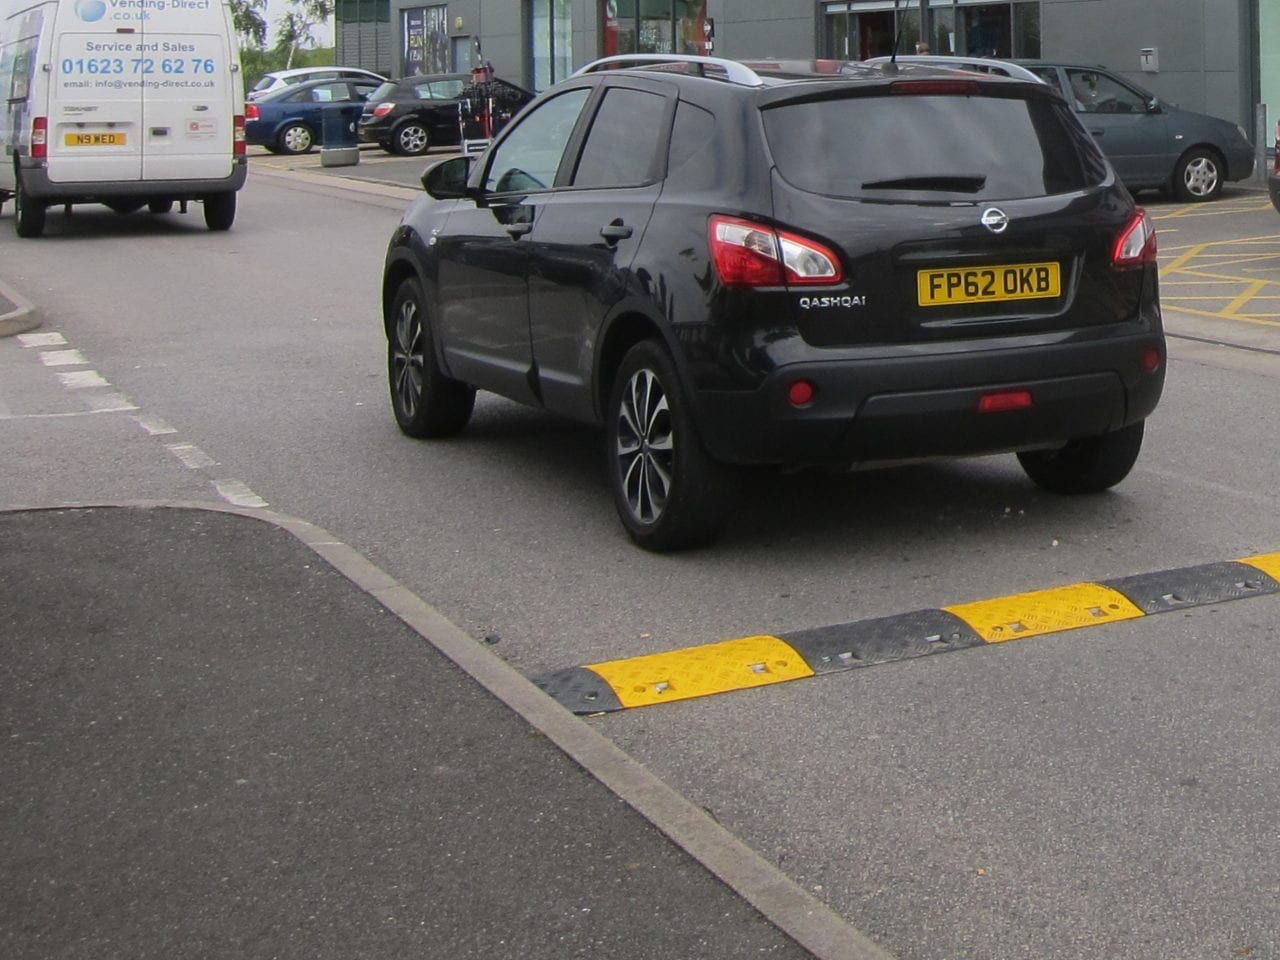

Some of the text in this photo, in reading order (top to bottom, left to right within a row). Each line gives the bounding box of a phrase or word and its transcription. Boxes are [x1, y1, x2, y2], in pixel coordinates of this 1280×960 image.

[86, 42, 195, 52] Service and Sales
[61, 58, 215, 74] 01623 72 62 76
[928, 267, 1050, 300] FP62 OKB
